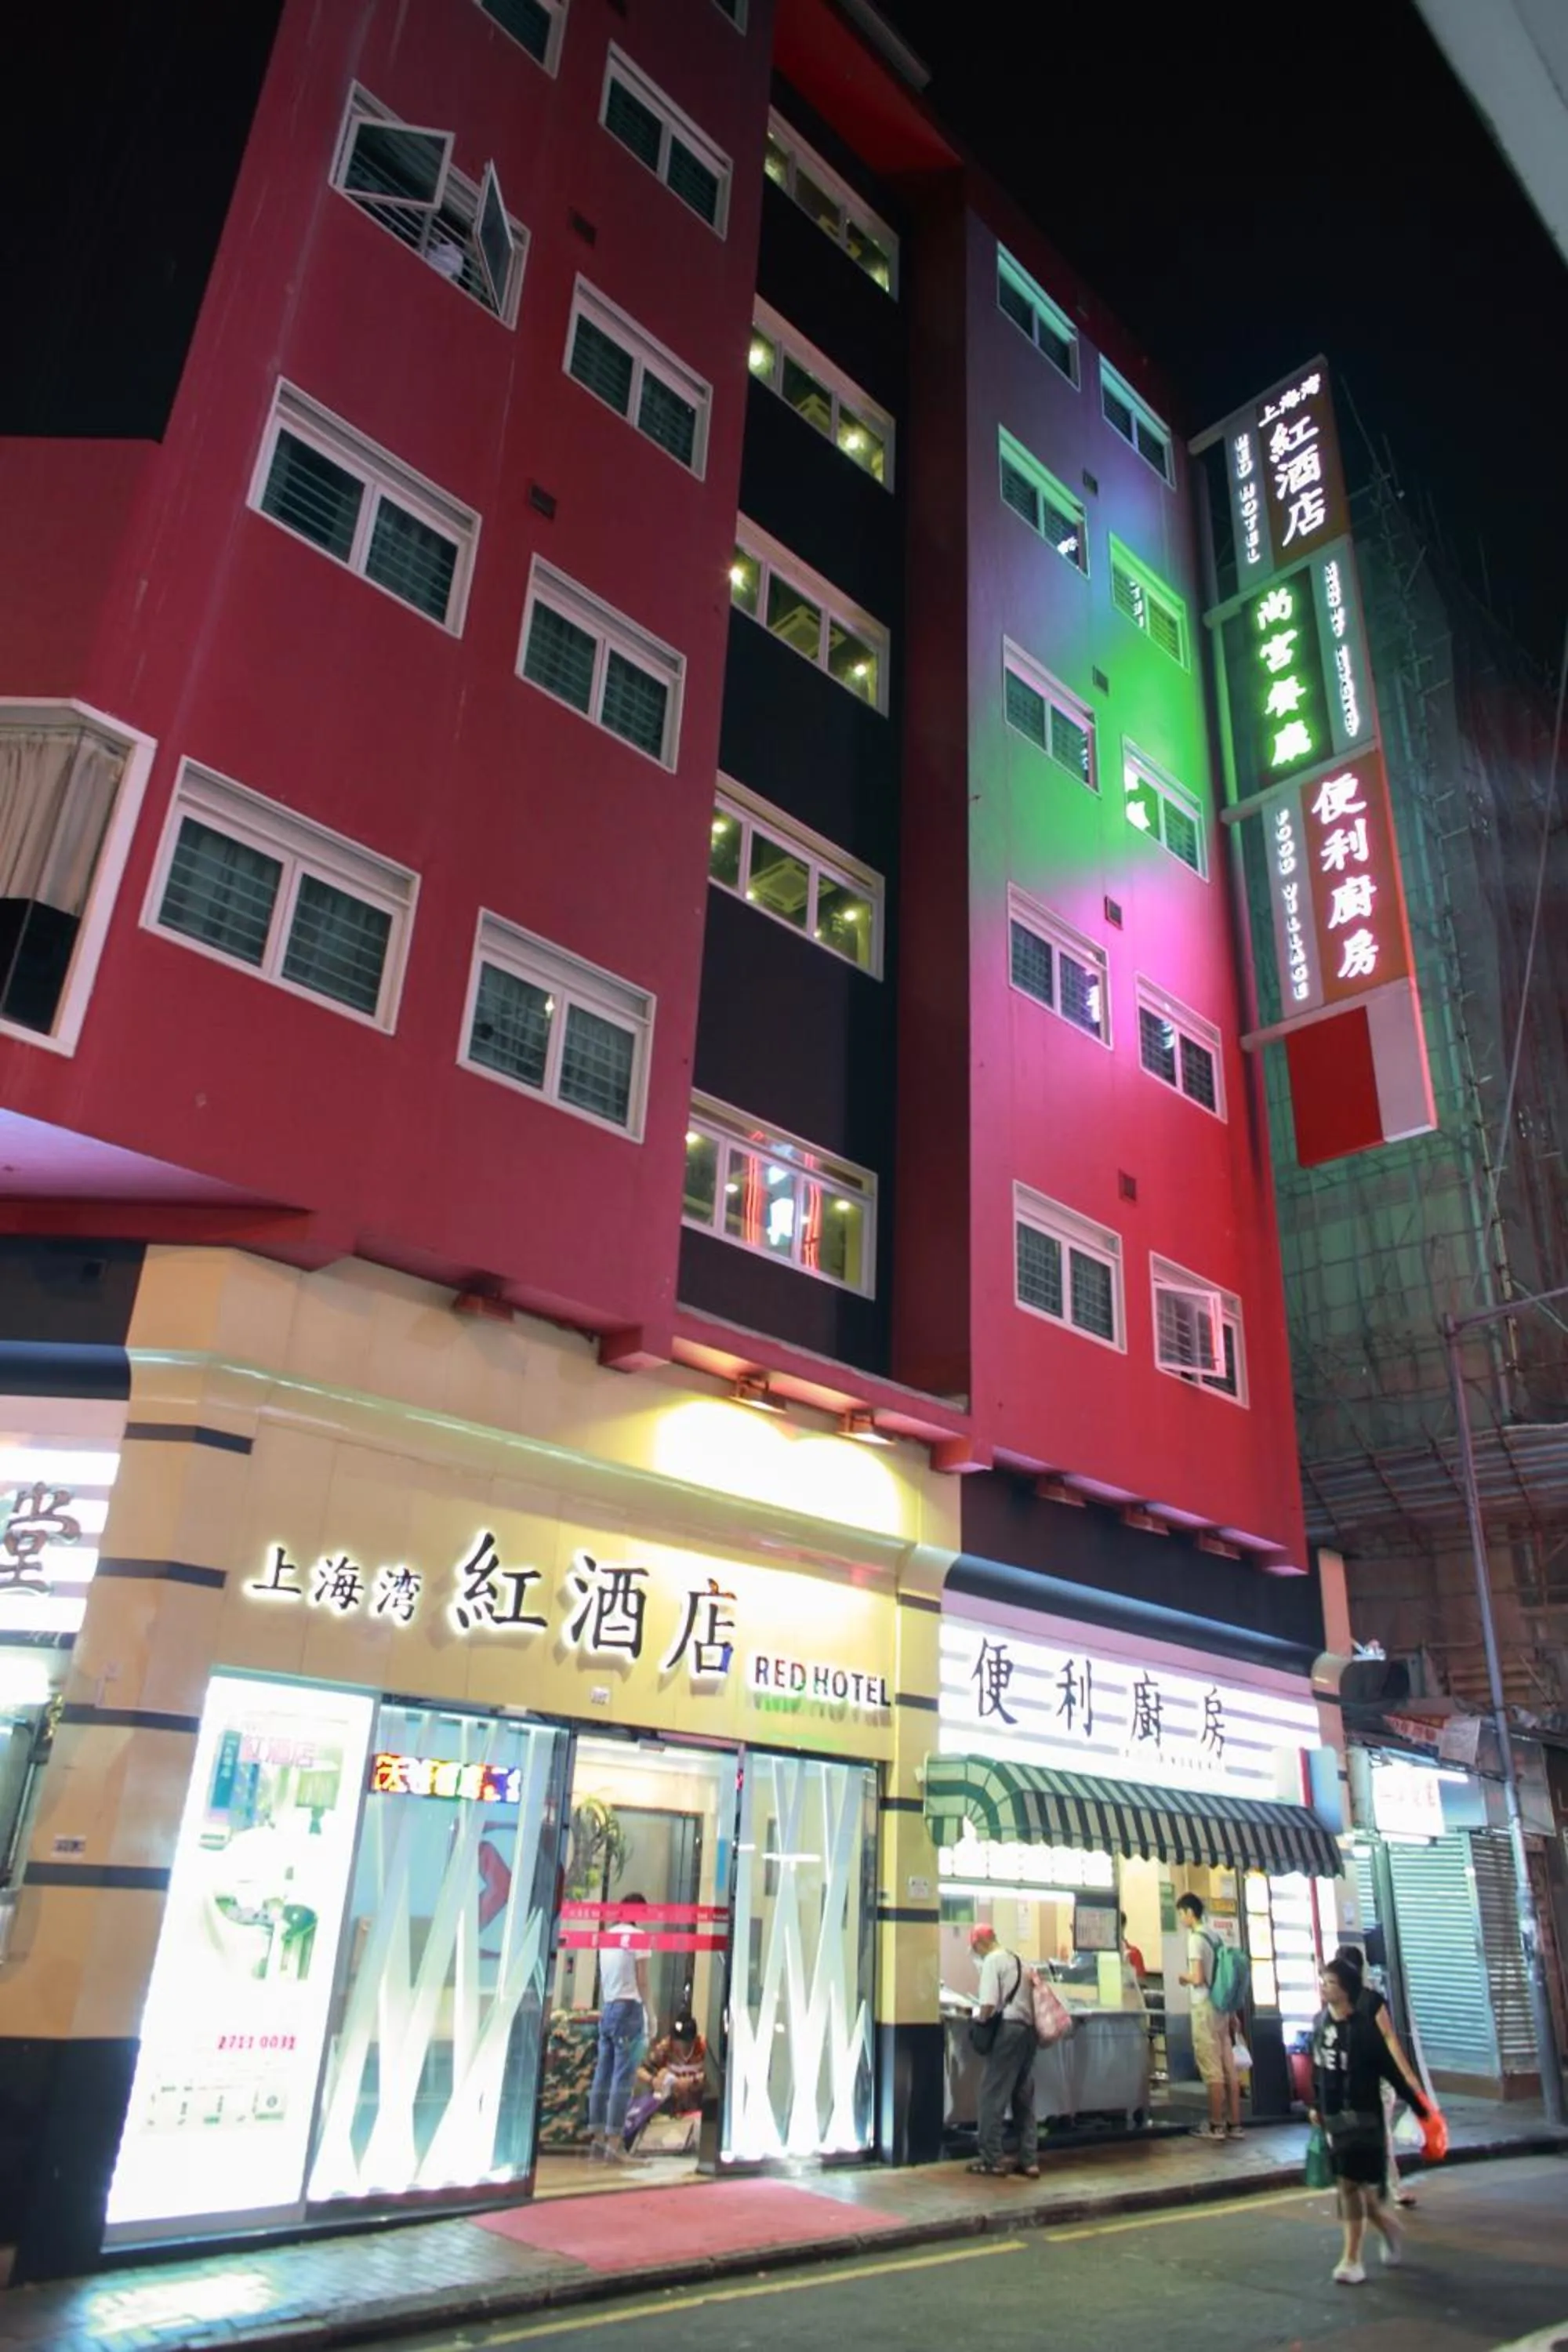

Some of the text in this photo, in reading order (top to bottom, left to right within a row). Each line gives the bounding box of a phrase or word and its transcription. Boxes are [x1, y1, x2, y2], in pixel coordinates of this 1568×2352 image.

[1269, 415, 1327, 547] 紅酒店
[252, 1530, 738, 1675] 上海湾 紅酒店
[754, 1654, 892, 1708] RED HOTEL
[971, 1635, 1226, 1760] 便利廚房
